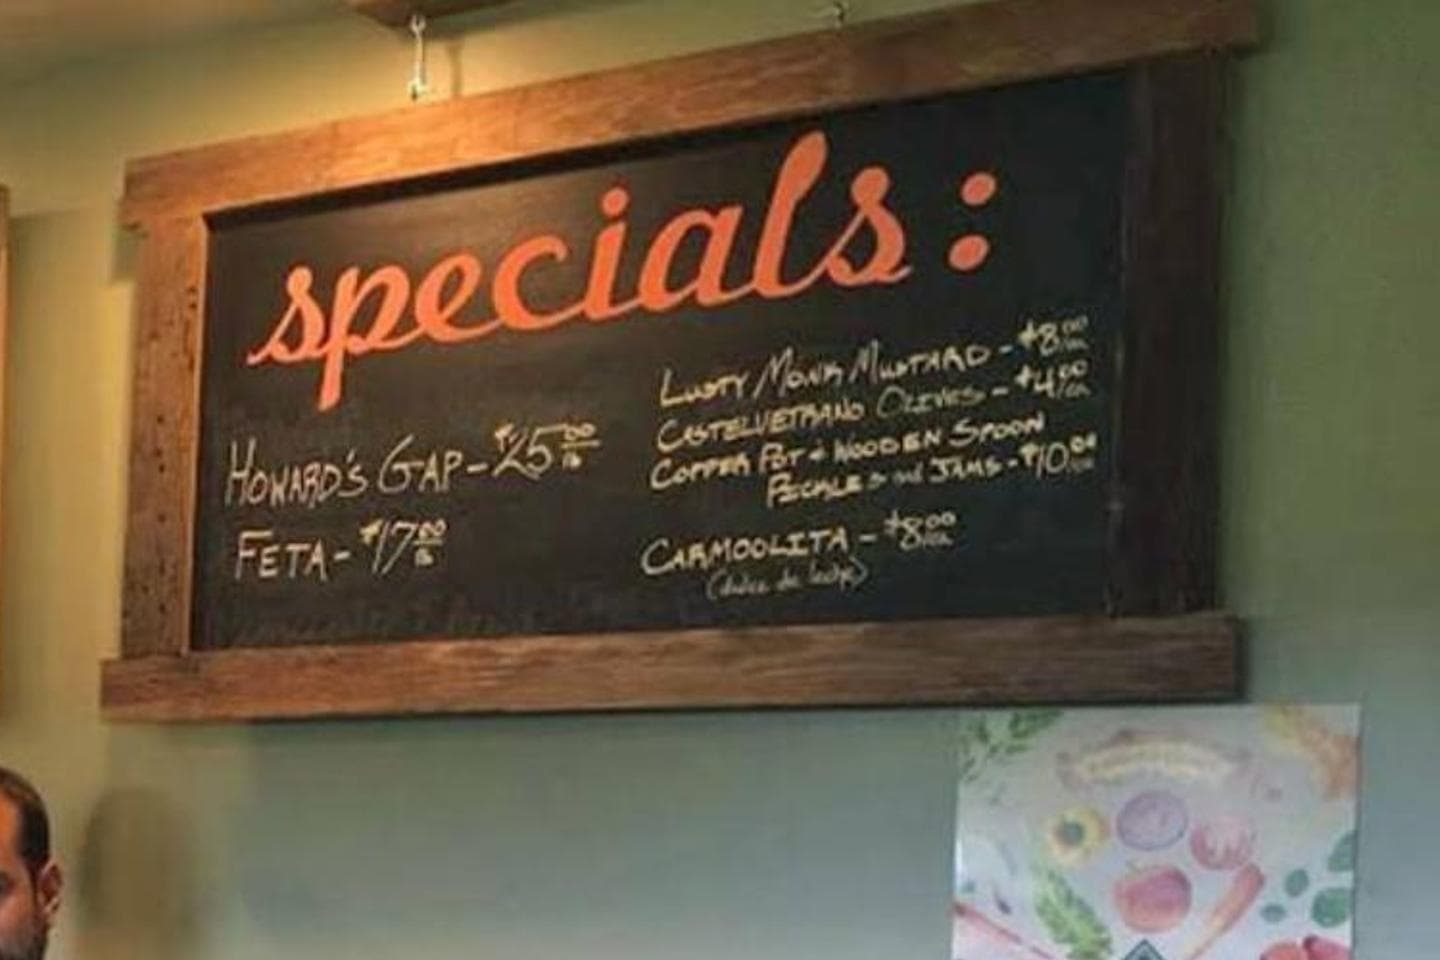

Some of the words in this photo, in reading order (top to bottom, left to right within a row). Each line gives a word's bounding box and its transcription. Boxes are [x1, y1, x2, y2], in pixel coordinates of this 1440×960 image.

[850, 339, 992, 386] MUSTARD
[834, 431, 944, 464] WOODEN
[950, 410, 1047, 448] SPOON
[224, 436, 370, 510] HOWARD'S
[376, 433, 464, 495] GAP
[928, 456, 1003, 485] JAMS
[235, 529, 330, 582] FETA
[641, 525, 850, 576] CARMOOLITA
